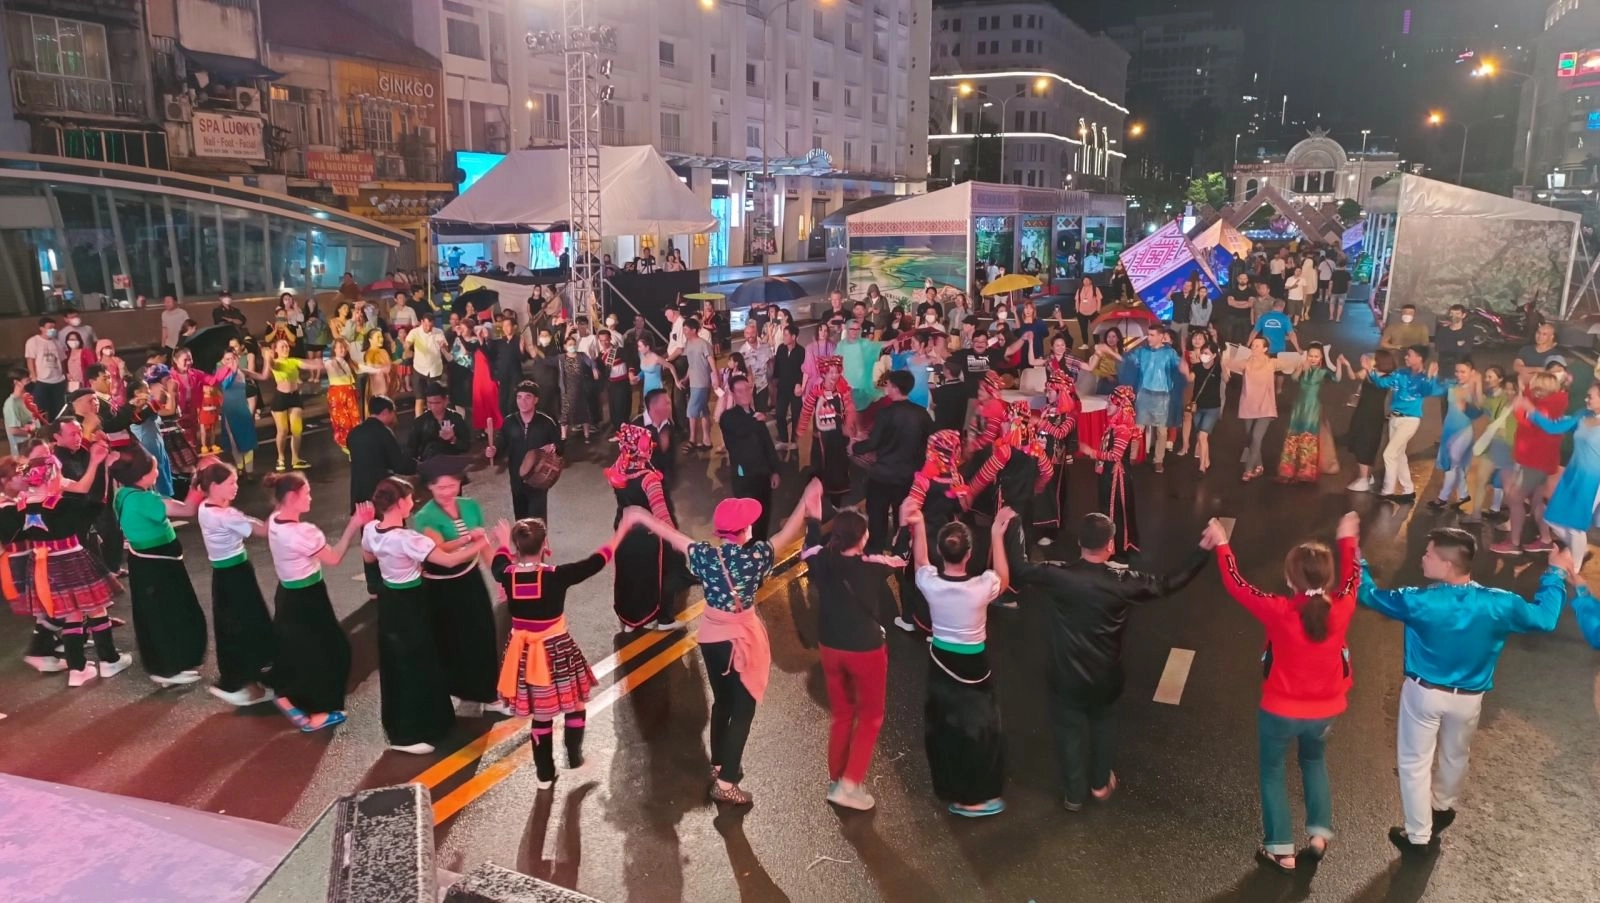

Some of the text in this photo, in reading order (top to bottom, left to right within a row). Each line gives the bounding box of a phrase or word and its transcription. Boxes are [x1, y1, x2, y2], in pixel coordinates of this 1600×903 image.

[379, 76, 434, 98] GINKGO
[199, 118, 256, 136] SPA LUCKY
[203, 136, 216, 147] Nail
[220, 137, 234, 149] Foot
[239, 138, 257, 149] Facial
